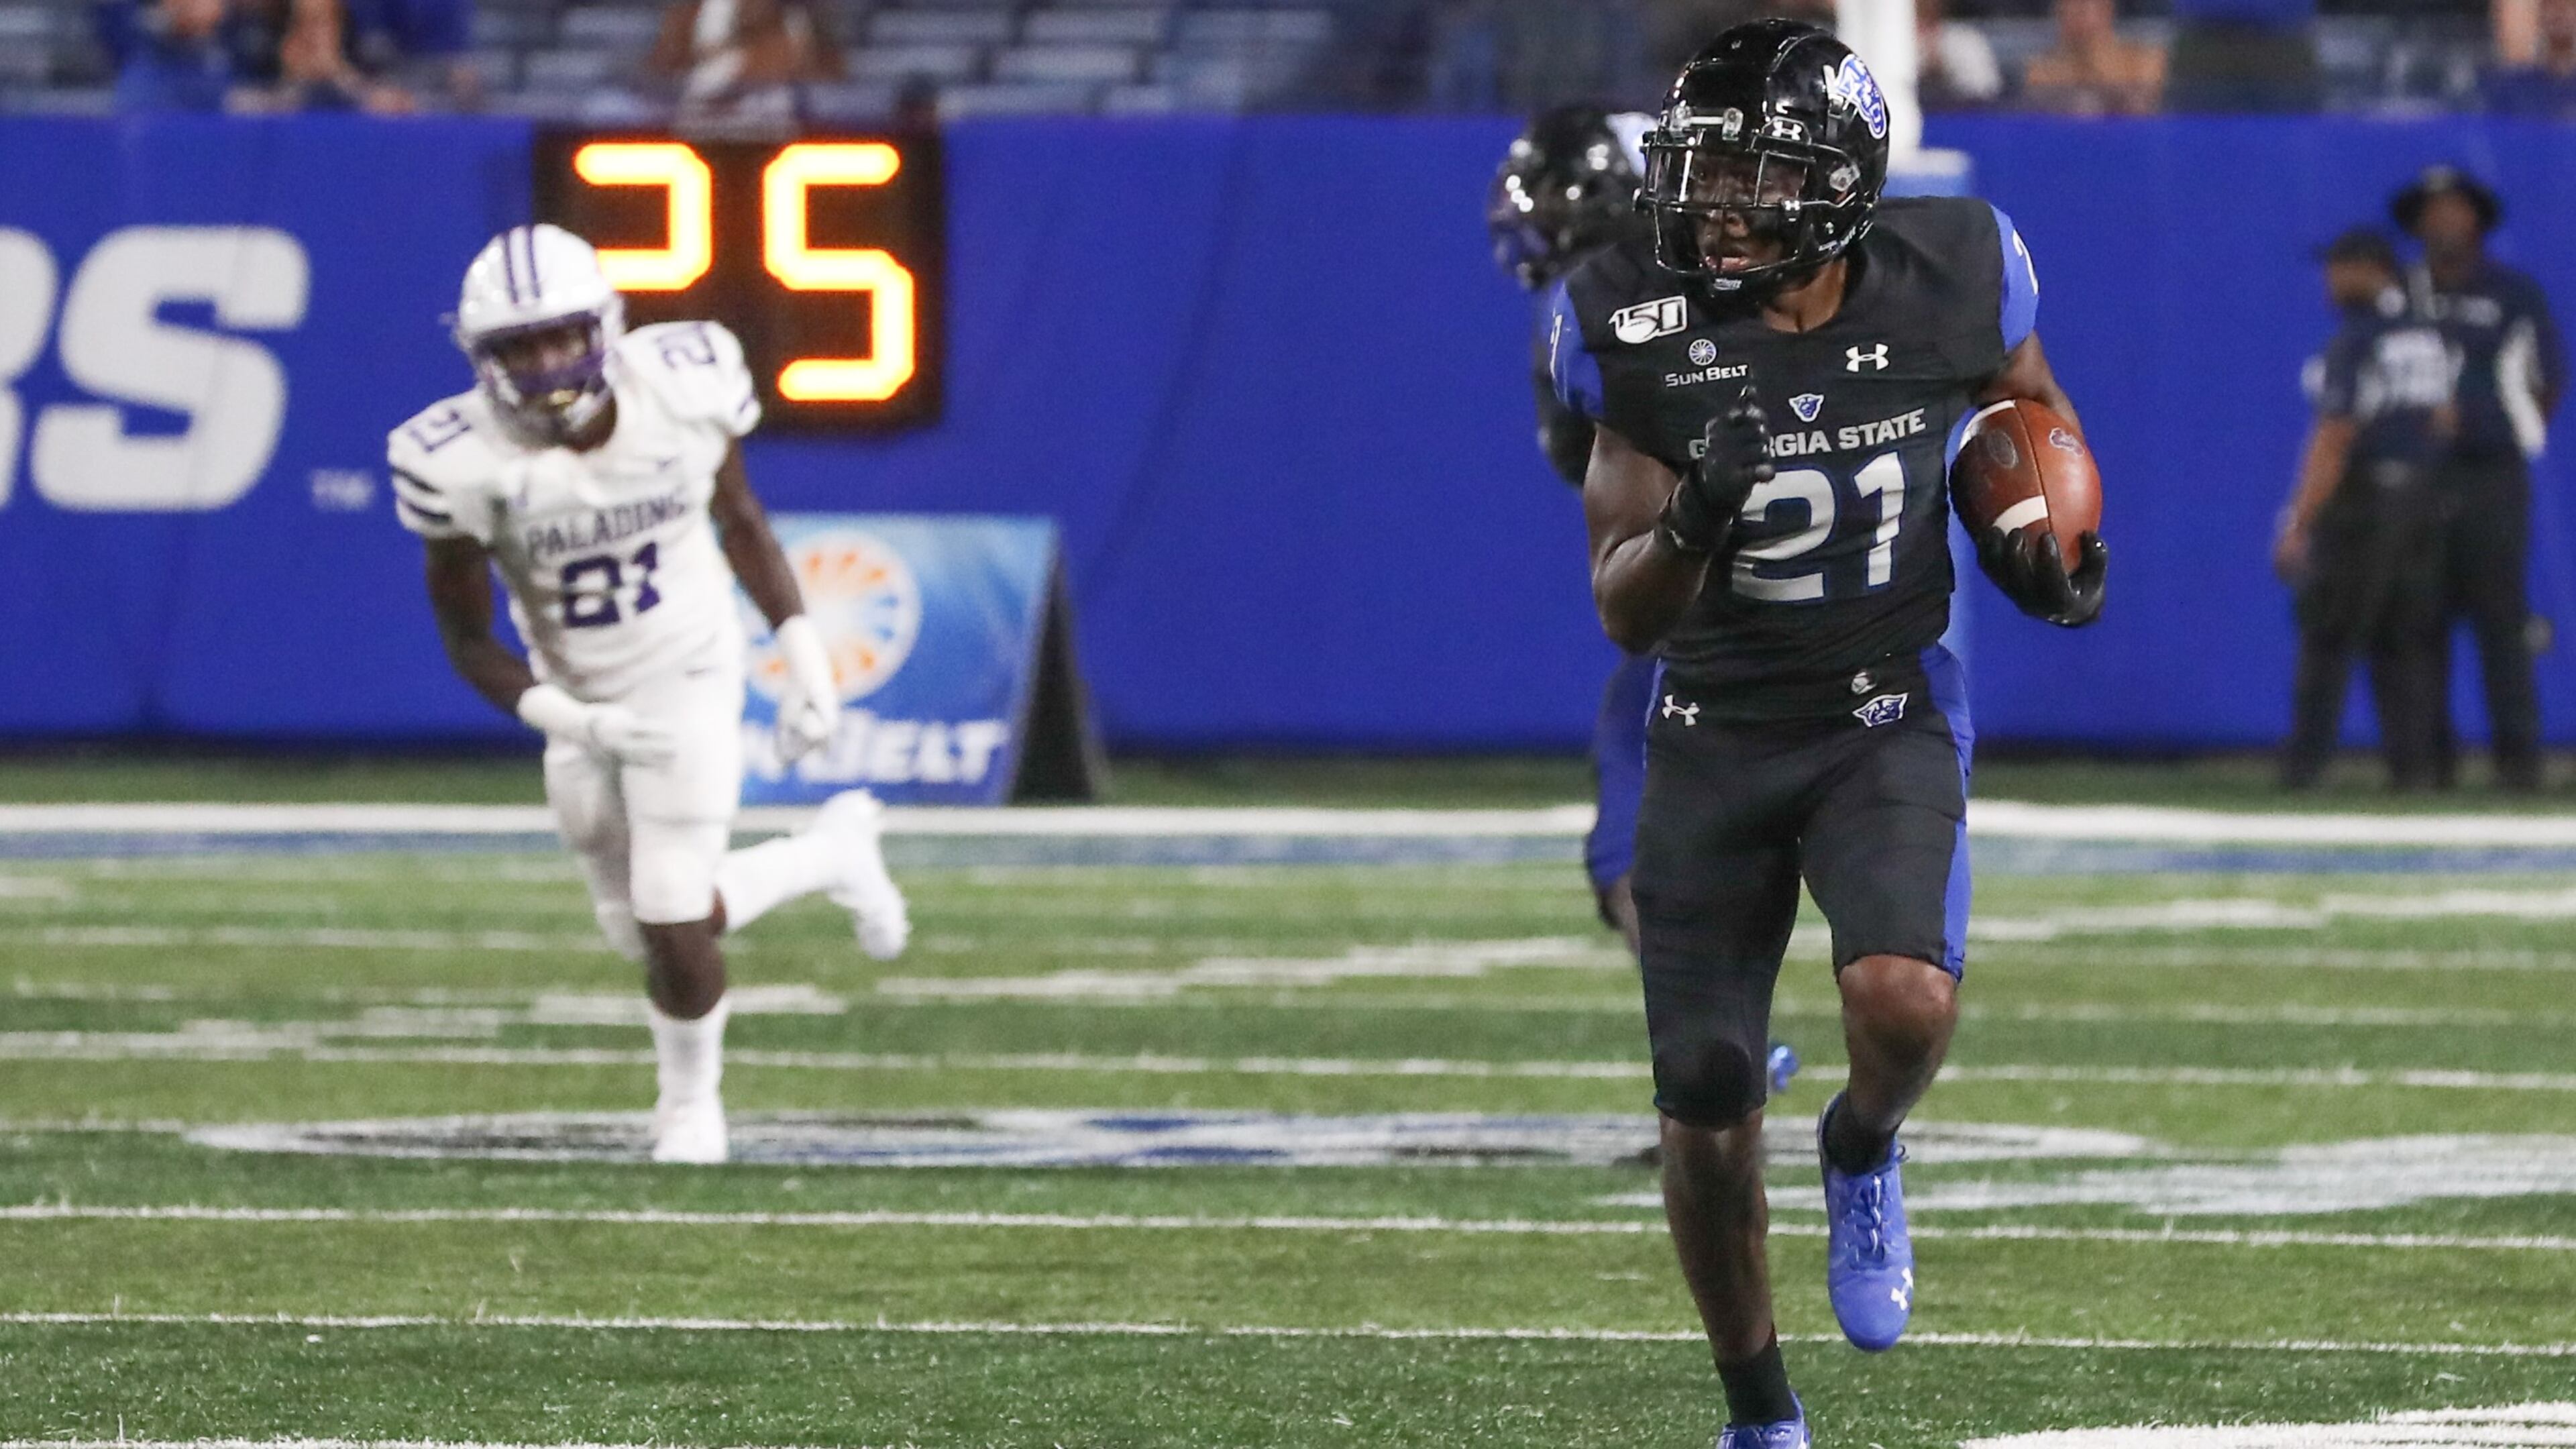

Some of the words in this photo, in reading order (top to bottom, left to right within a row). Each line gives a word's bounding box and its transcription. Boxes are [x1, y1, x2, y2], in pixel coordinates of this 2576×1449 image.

[574, 142, 914, 401] 25
[0, 225, 310, 512] S
[1664, 372, 1704, 387] SUN
[1705, 364, 1748, 382] BELT
[1688, 430, 1832, 460] GGIA
[1837, 408, 1927, 449] STATE
[561, 541, 661, 629] 21
[1731, 451, 1906, 602] 21
